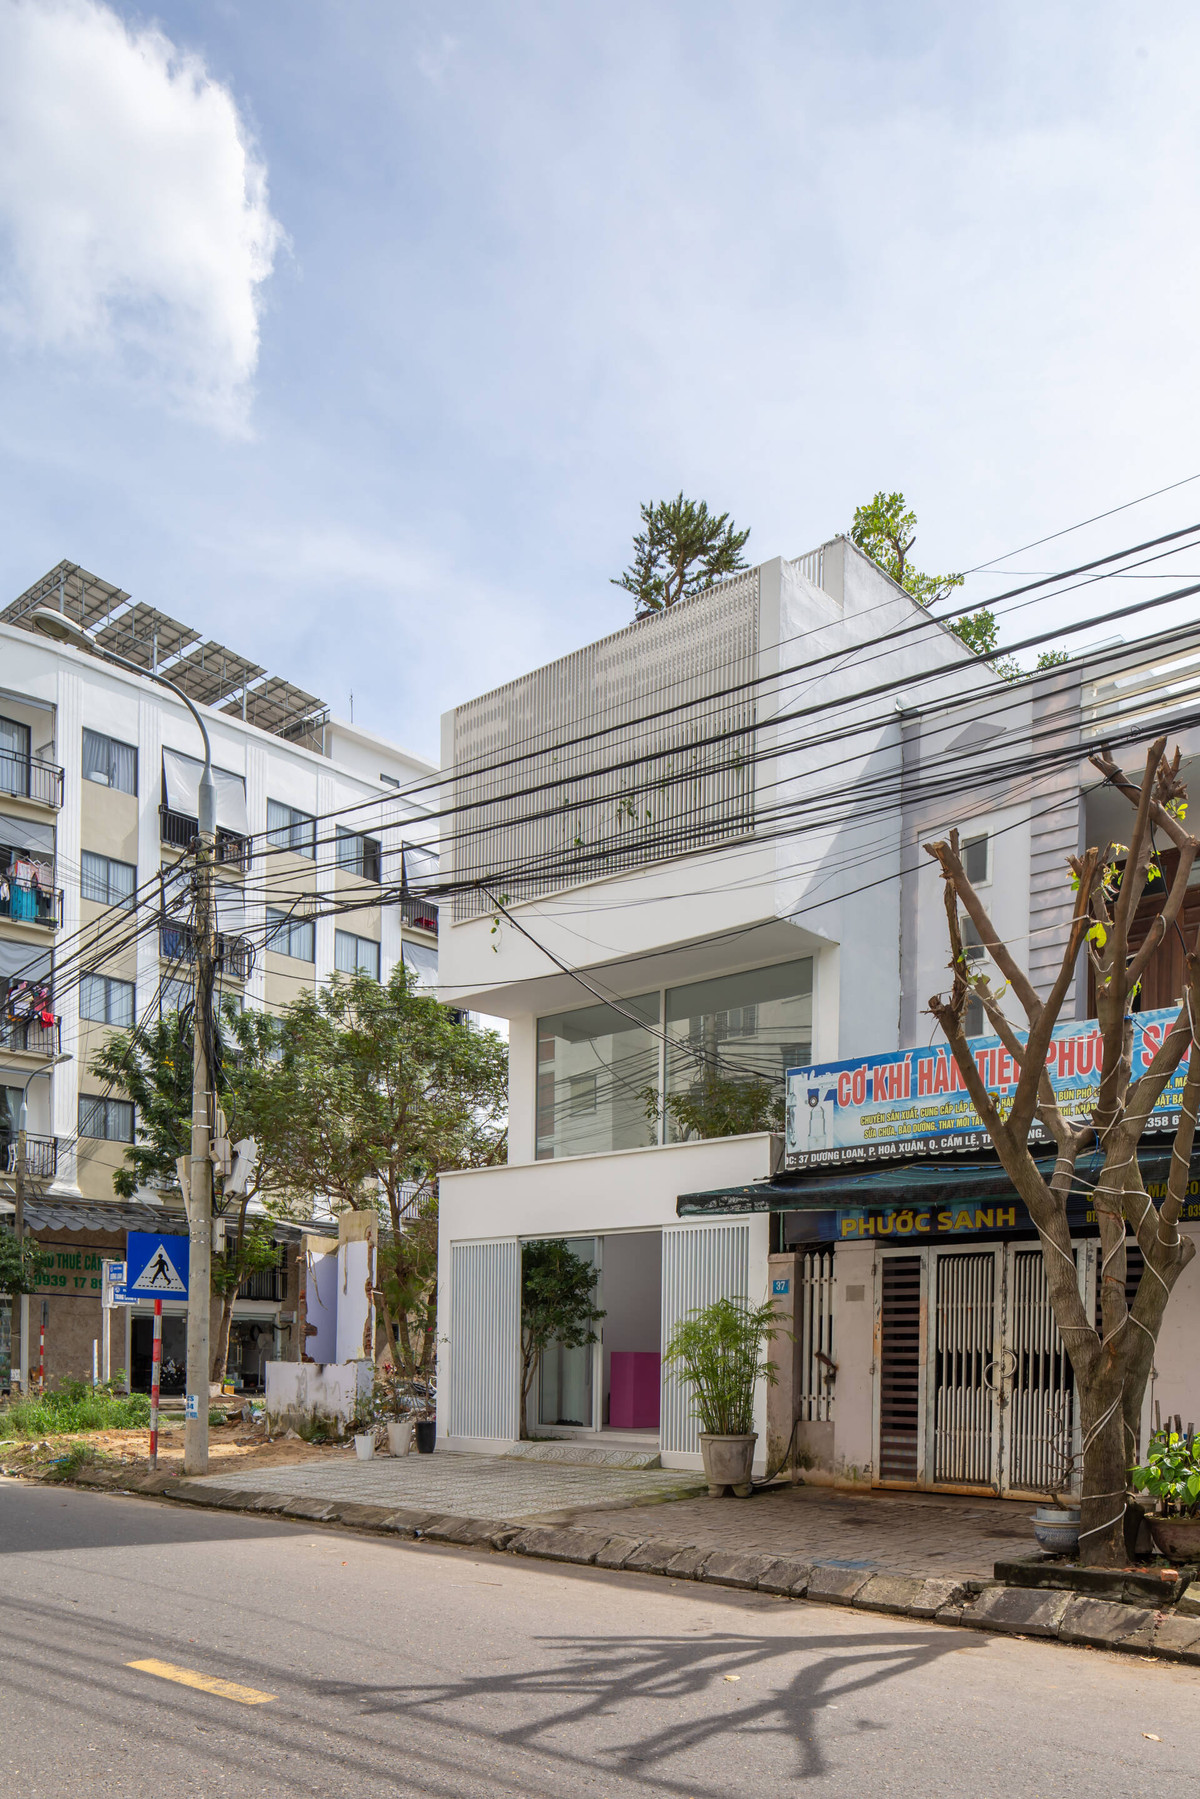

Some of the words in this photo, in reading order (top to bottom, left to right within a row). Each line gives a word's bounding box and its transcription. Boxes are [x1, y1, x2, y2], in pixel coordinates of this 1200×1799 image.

[837, 1064, 868, 1107] CƠ
[873, 1053, 913, 1102] KHÍ
[917, 1048, 967, 1096] HÀN
[860, 1113, 885, 1126] CHUYÊN
[920, 1106, 939, 1118] CUNG
[940, 1101, 954, 1115] CẤP
[1058, 1088, 1075, 1101] BÚN
[938, 1116, 956, 1128] THAY
[798, 1154, 809, 1164] 37
[810, 1150, 840, 1162] DƯƠNG
[841, 1147, 867, 1159] LOAN,
[868, 1147, 876, 1156] P.
[878, 1142, 896, 1154] HOÀ
[898, 1140, 927, 1153] XUÂN,
[929, 1140, 938, 1149] Q.
[965, 1133, 980, 1146] LỆ,
[841, 1209, 931, 1237] PHƯỚC
[937, 1207, 1016, 1231] SANH
[56, 1251, 82, 1270] THUÊ
[73, 1277, 87, 1289] 17
[775, 1280, 786, 1291] 37
